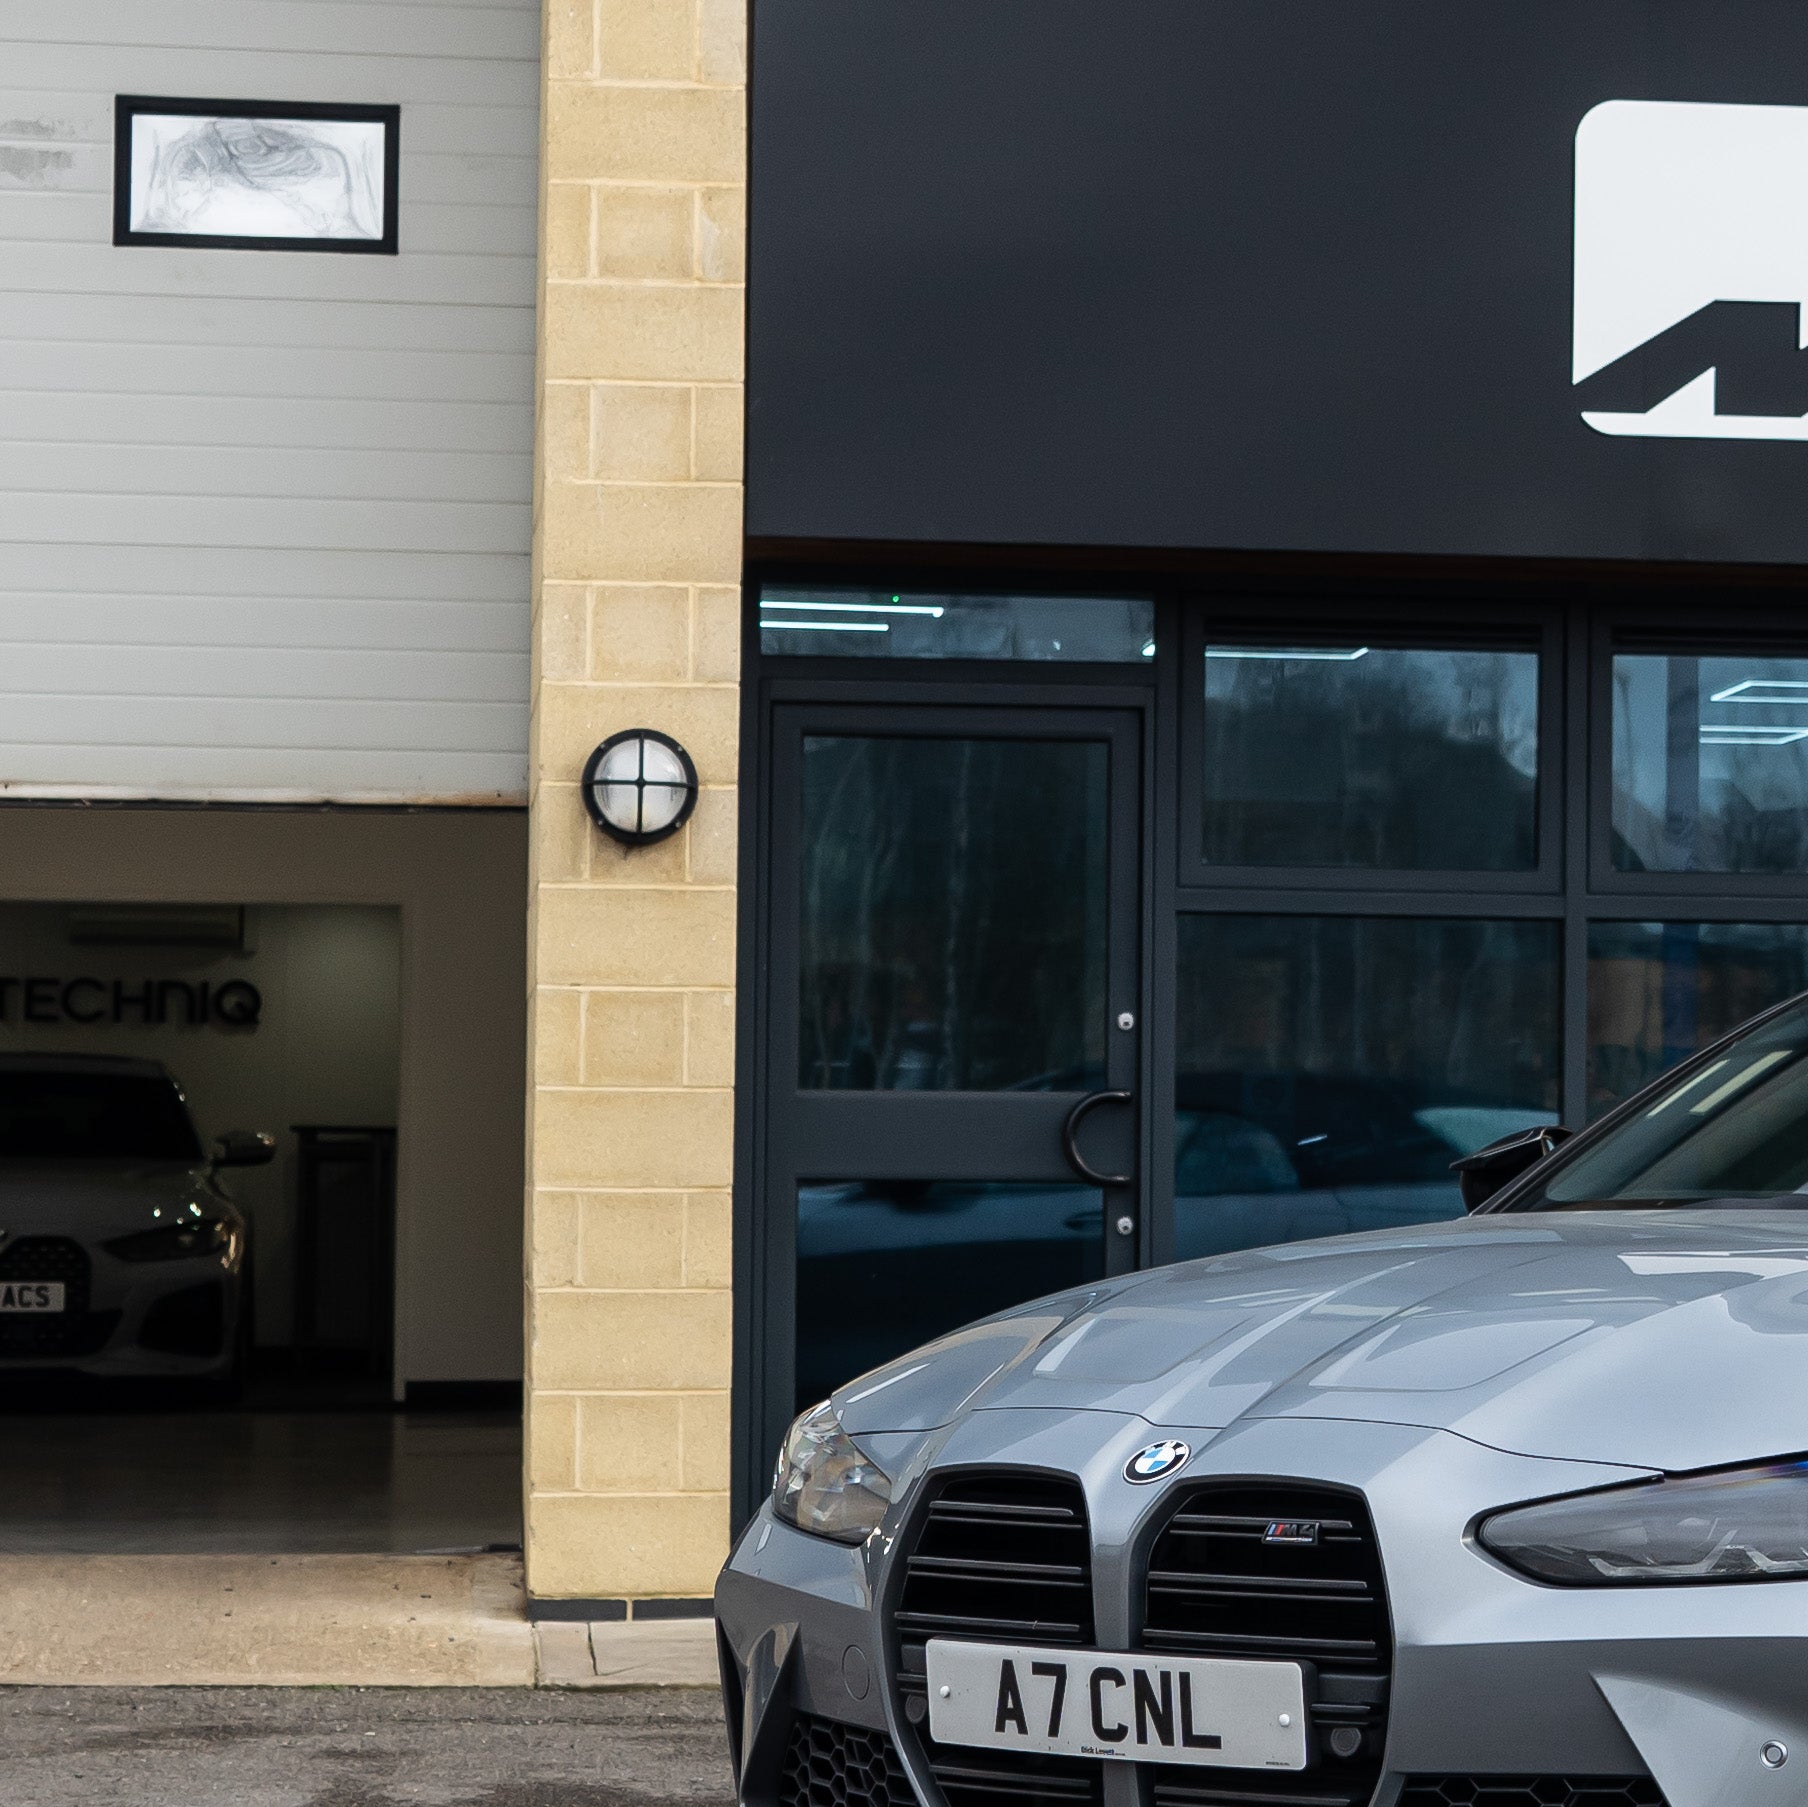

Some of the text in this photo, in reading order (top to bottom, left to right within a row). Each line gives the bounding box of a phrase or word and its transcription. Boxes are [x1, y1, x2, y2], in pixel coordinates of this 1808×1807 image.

[2, 1284, 51, 1308] ACS
[994, 1658, 1222, 1750] A7 CNL
